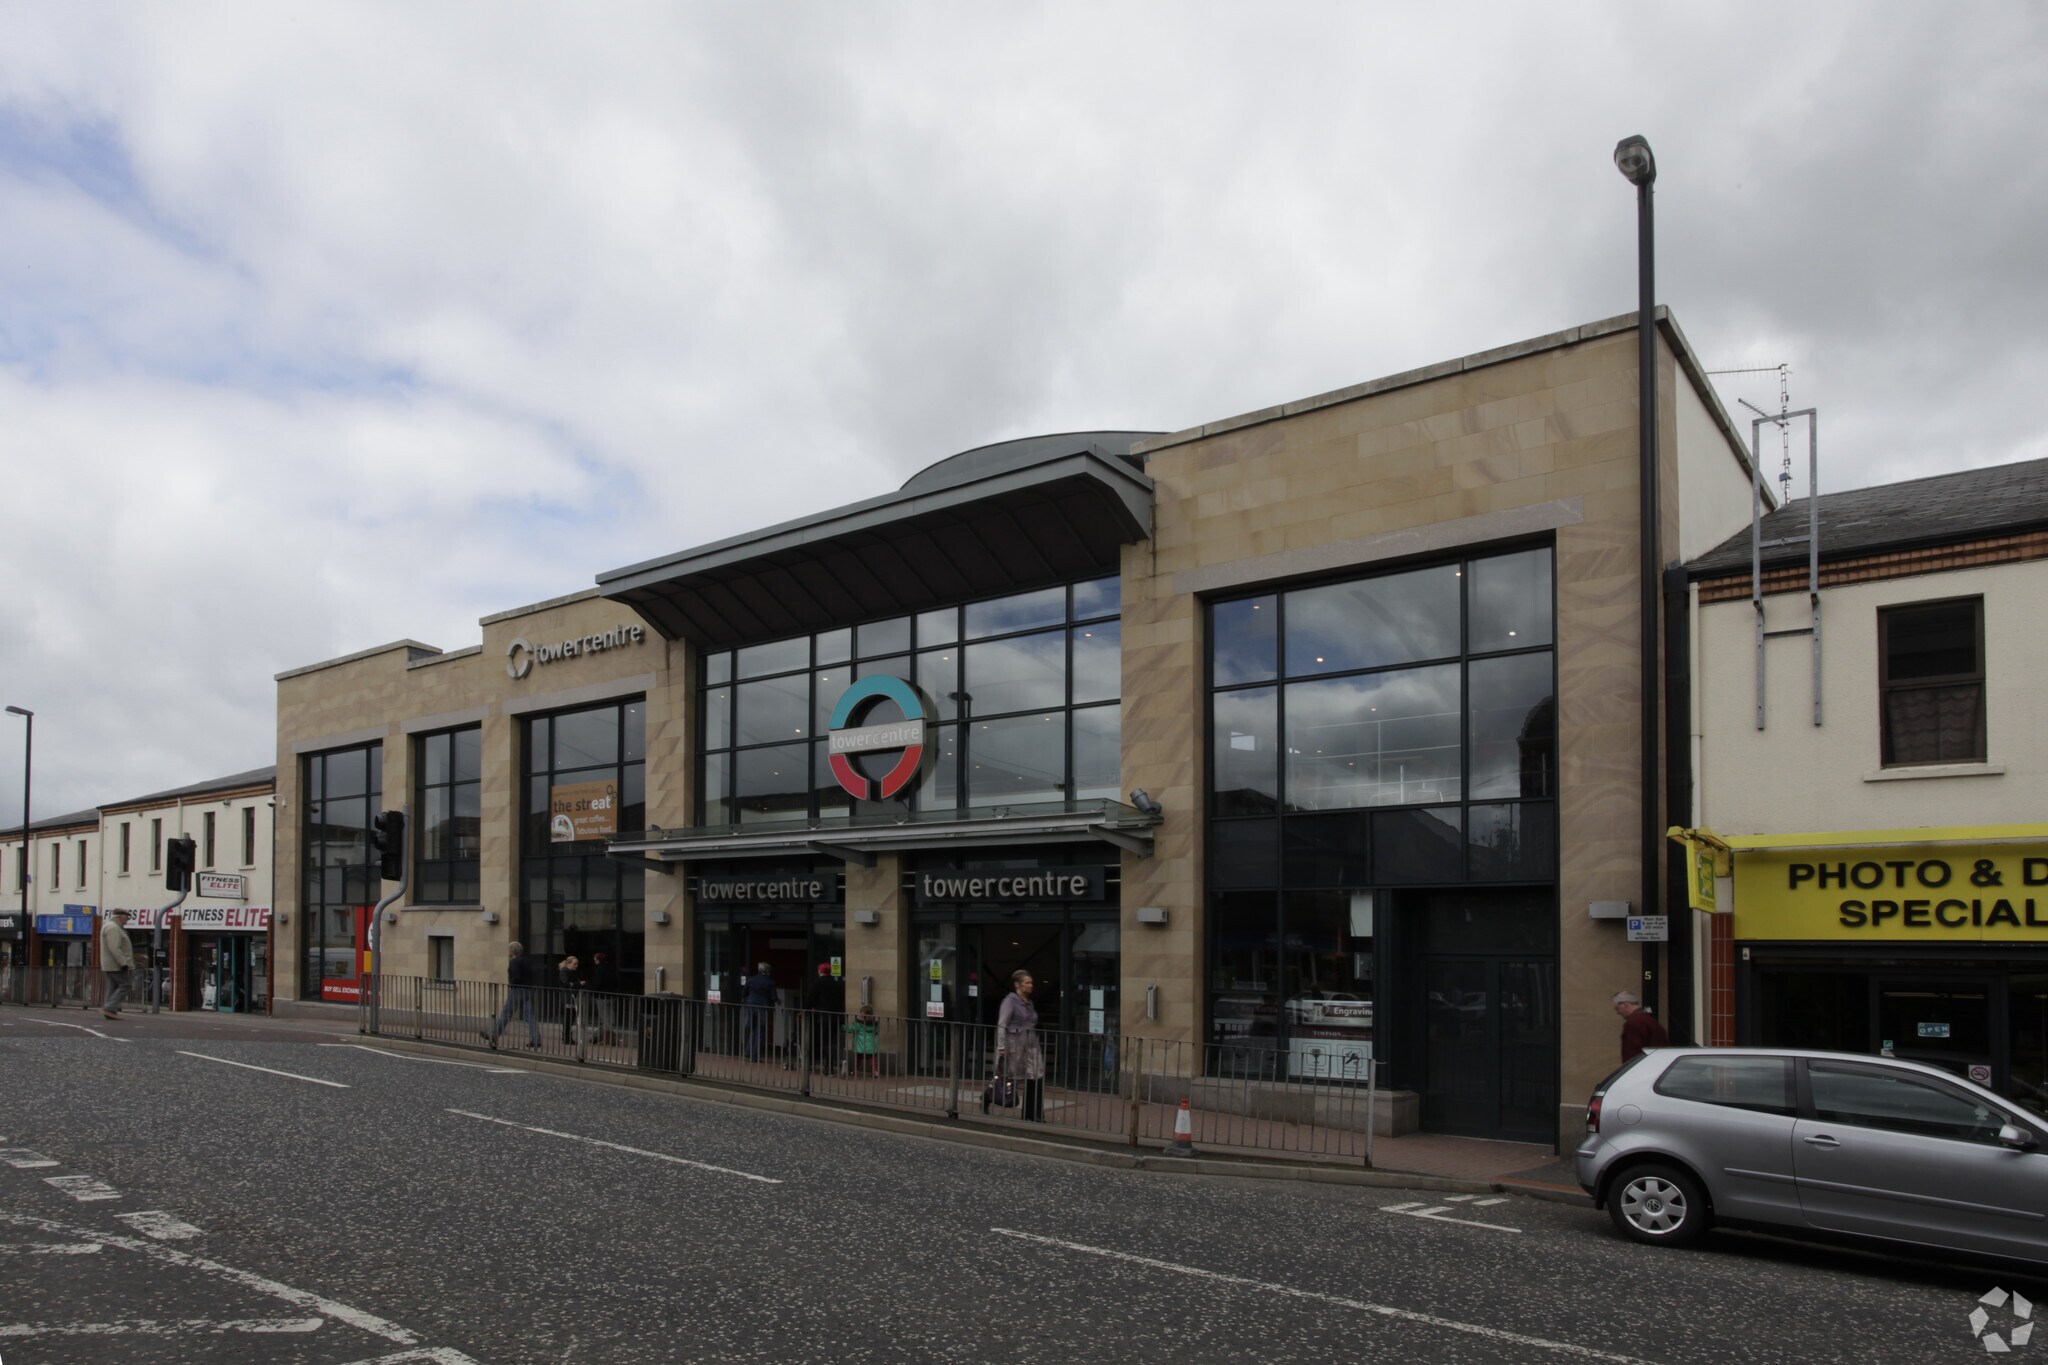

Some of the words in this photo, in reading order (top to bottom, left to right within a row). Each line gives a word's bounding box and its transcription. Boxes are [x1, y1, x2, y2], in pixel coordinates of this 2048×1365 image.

[534, 624, 643, 662] towercentre
[832, 727, 920, 749] towercentre
[553, 800, 572, 813] the
[575, 795, 611, 811] streat
[574, 816, 589, 826] great
[576, 826, 599, 835] fabulous
[201, 876, 240, 884] FITNESS
[1788, 859, 1952, 890] PHOTO
[1969, 858, 2004, 888] &
[2022, 857, 2048, 887] D
[209, 881, 240, 890] ELITE
[702, 877, 821, 899] towercentre
[924, 871, 1086, 897] towercentre
[104, 909, 138, 920] FISS
[138, 908, 174, 926] ELIE
[182, 908, 224, 921] FITNESS
[224, 908, 269, 927] ELITE
[1839, 898, 2048, 928] SPECIAL
[1644, 971, 1652, 980] 5
[342, 986, 364, 995] EXCHANE
[1919, 1026, 1949, 1034] OPEN
